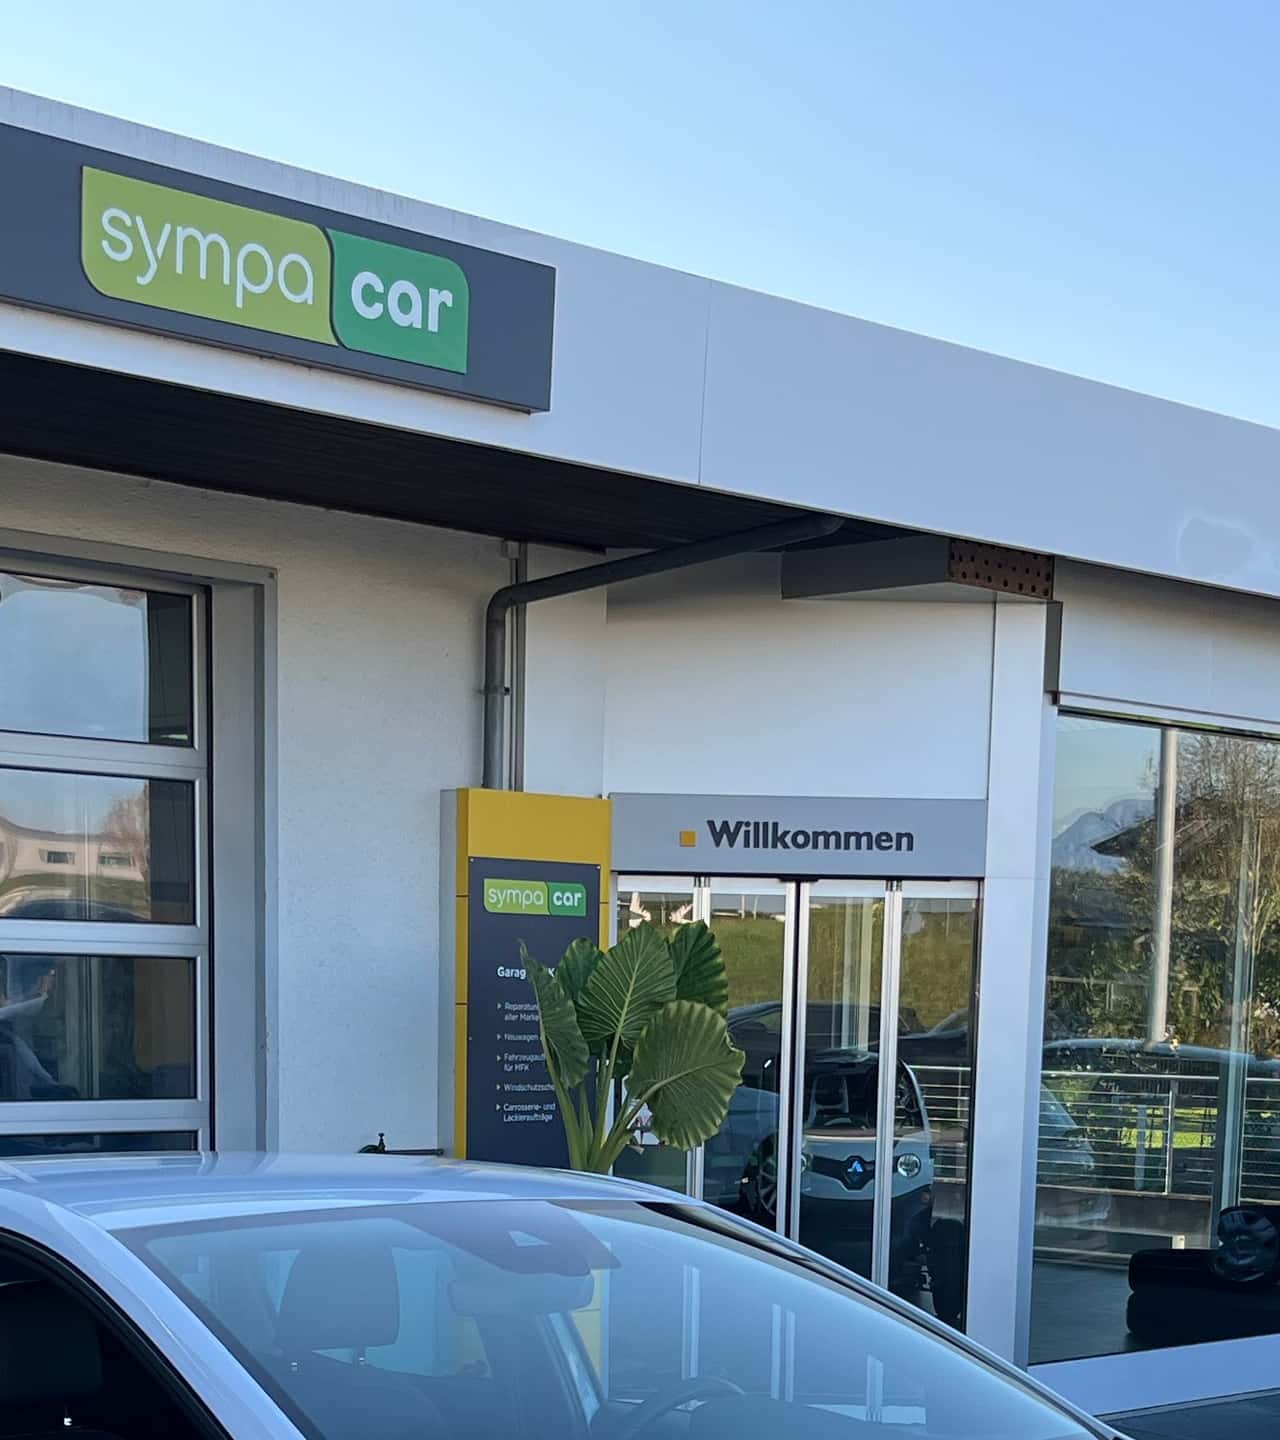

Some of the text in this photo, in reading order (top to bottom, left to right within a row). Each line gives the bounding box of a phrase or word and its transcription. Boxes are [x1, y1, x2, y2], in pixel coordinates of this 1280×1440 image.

[101, 207, 453, 333] sympa car
[706, 819, 915, 852] Willkommen
[487, 887, 582, 910] sympa car
[496, 966, 528, 981] Garag
